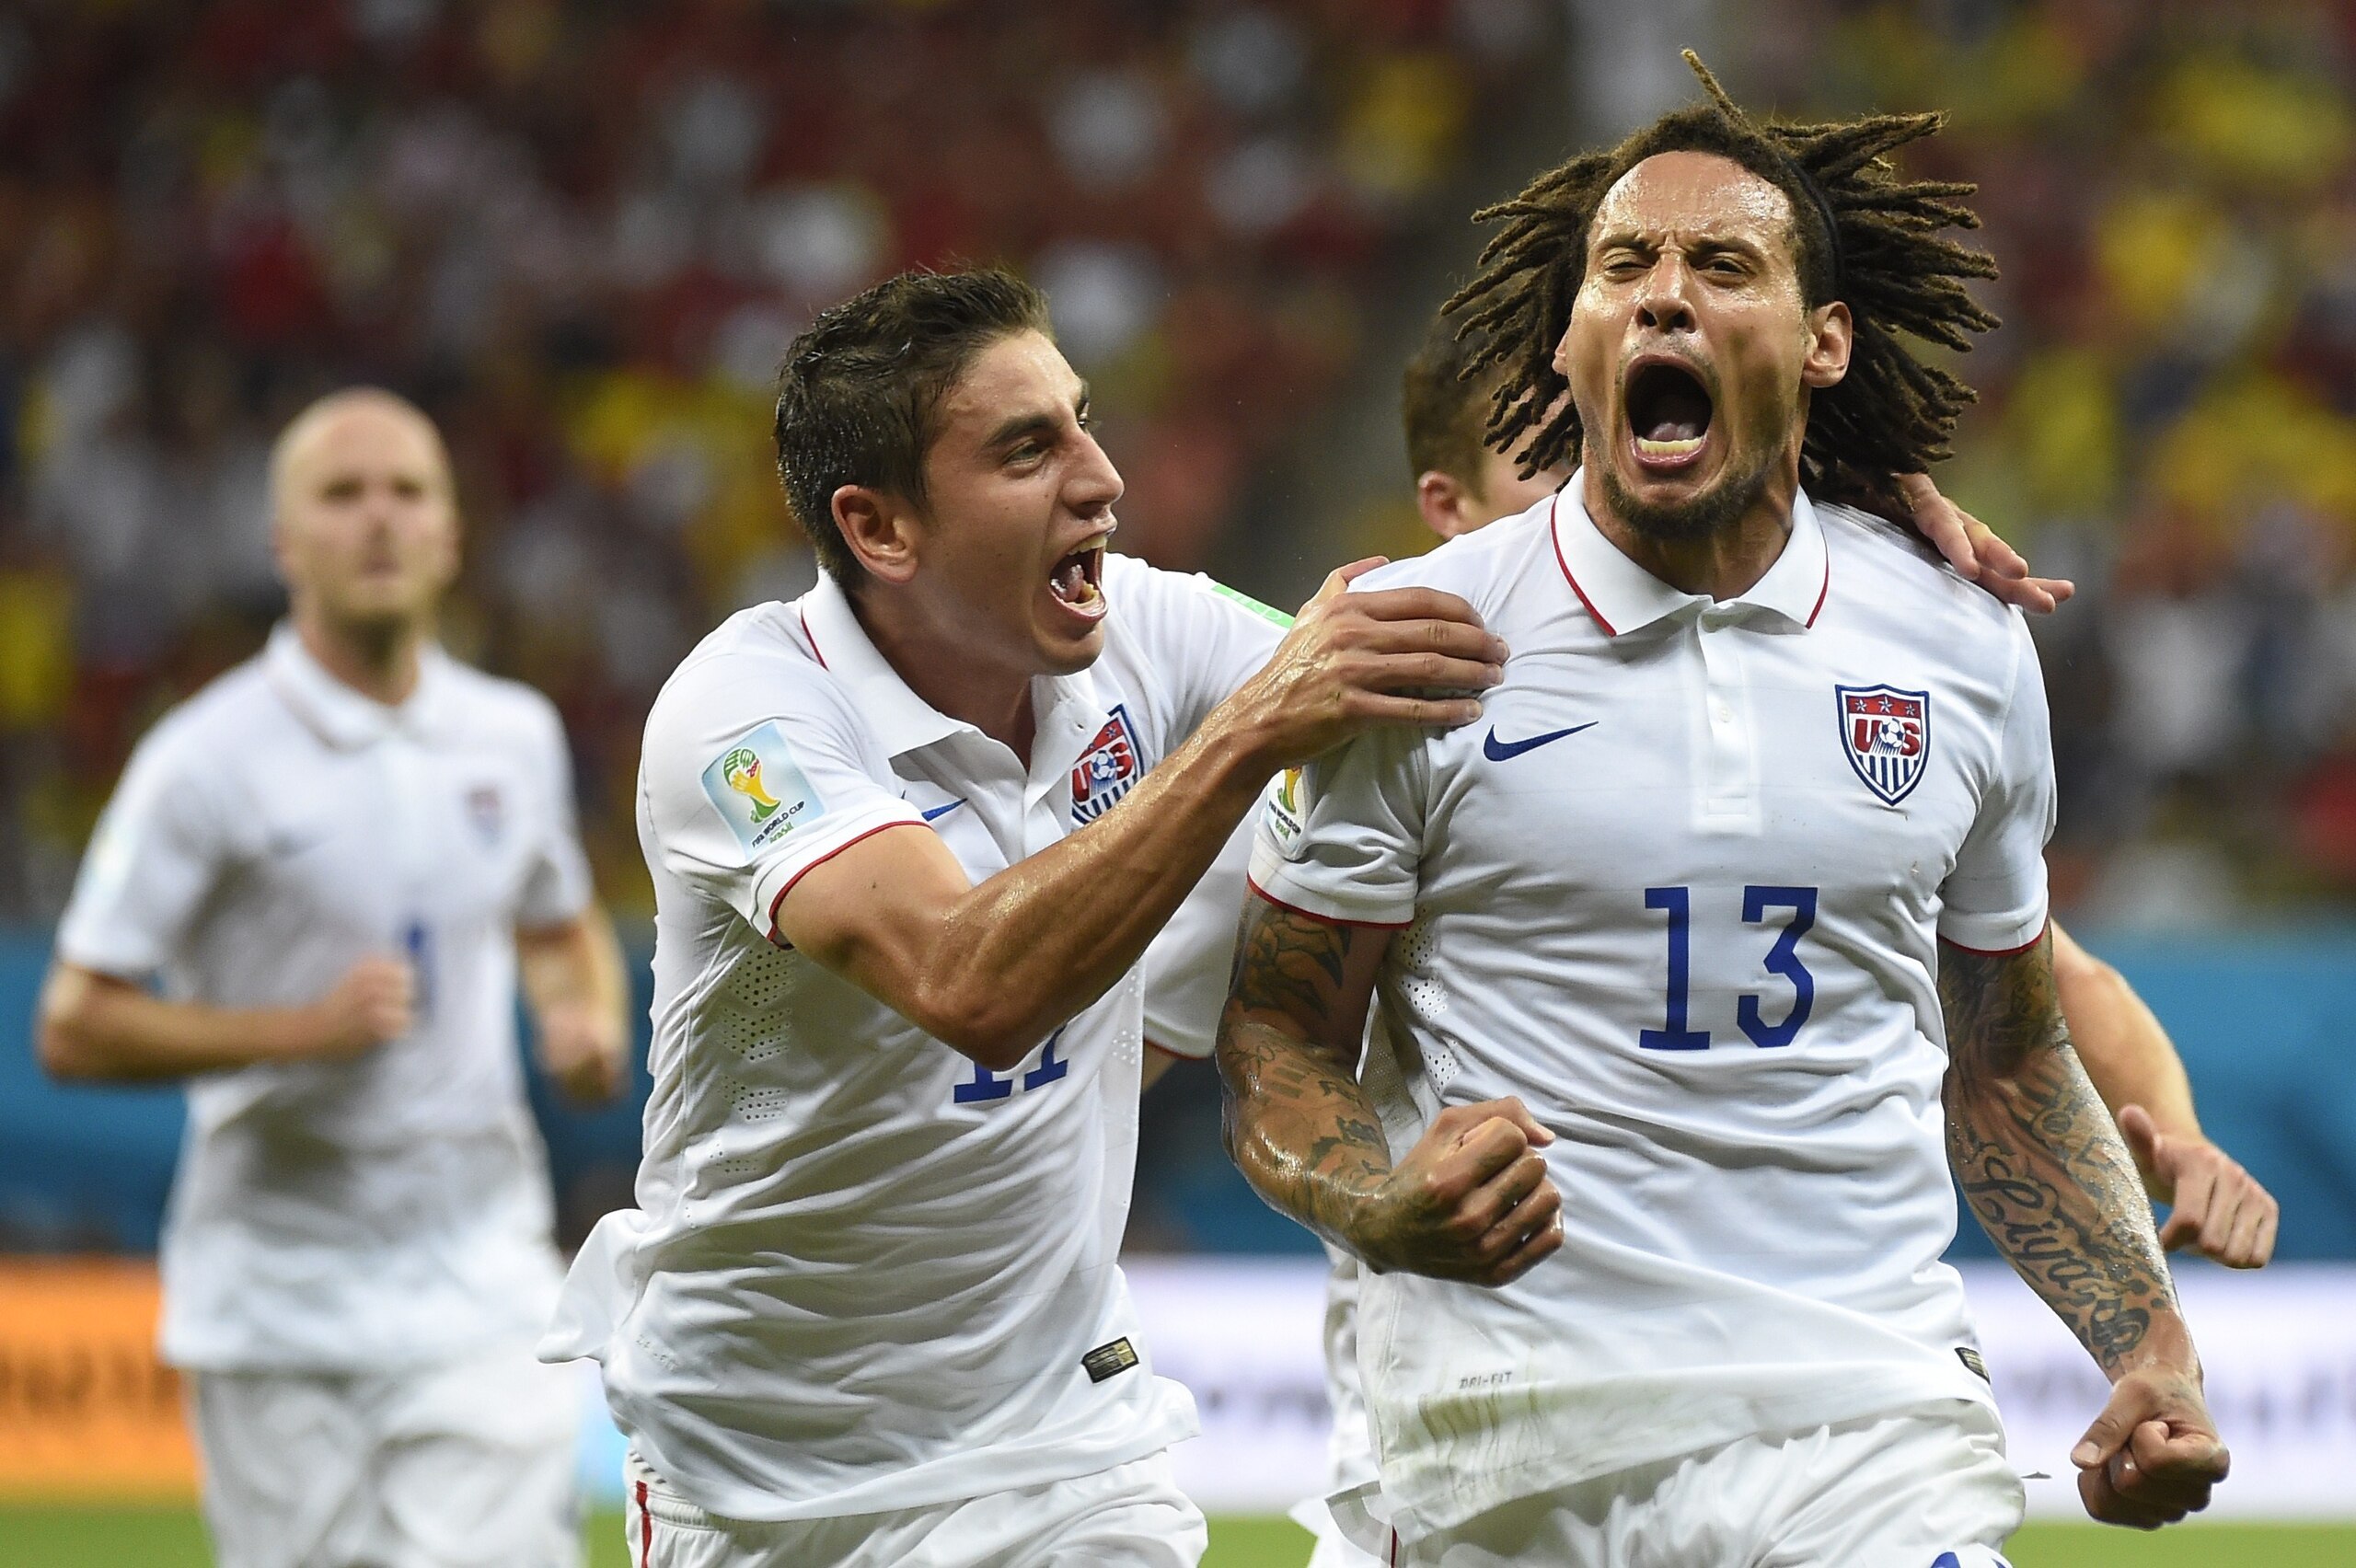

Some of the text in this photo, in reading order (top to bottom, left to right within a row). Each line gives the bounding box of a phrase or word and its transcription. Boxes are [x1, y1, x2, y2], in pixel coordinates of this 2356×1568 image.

[1854, 719, 1921, 756] US
[1072, 742, 1134, 802] US
[763, 812, 790, 836] WORLD
[789, 801, 805, 816] CUP
[1639, 885, 1818, 1051] 13
[1459, 1370, 1513, 1390] DRI-FIT
